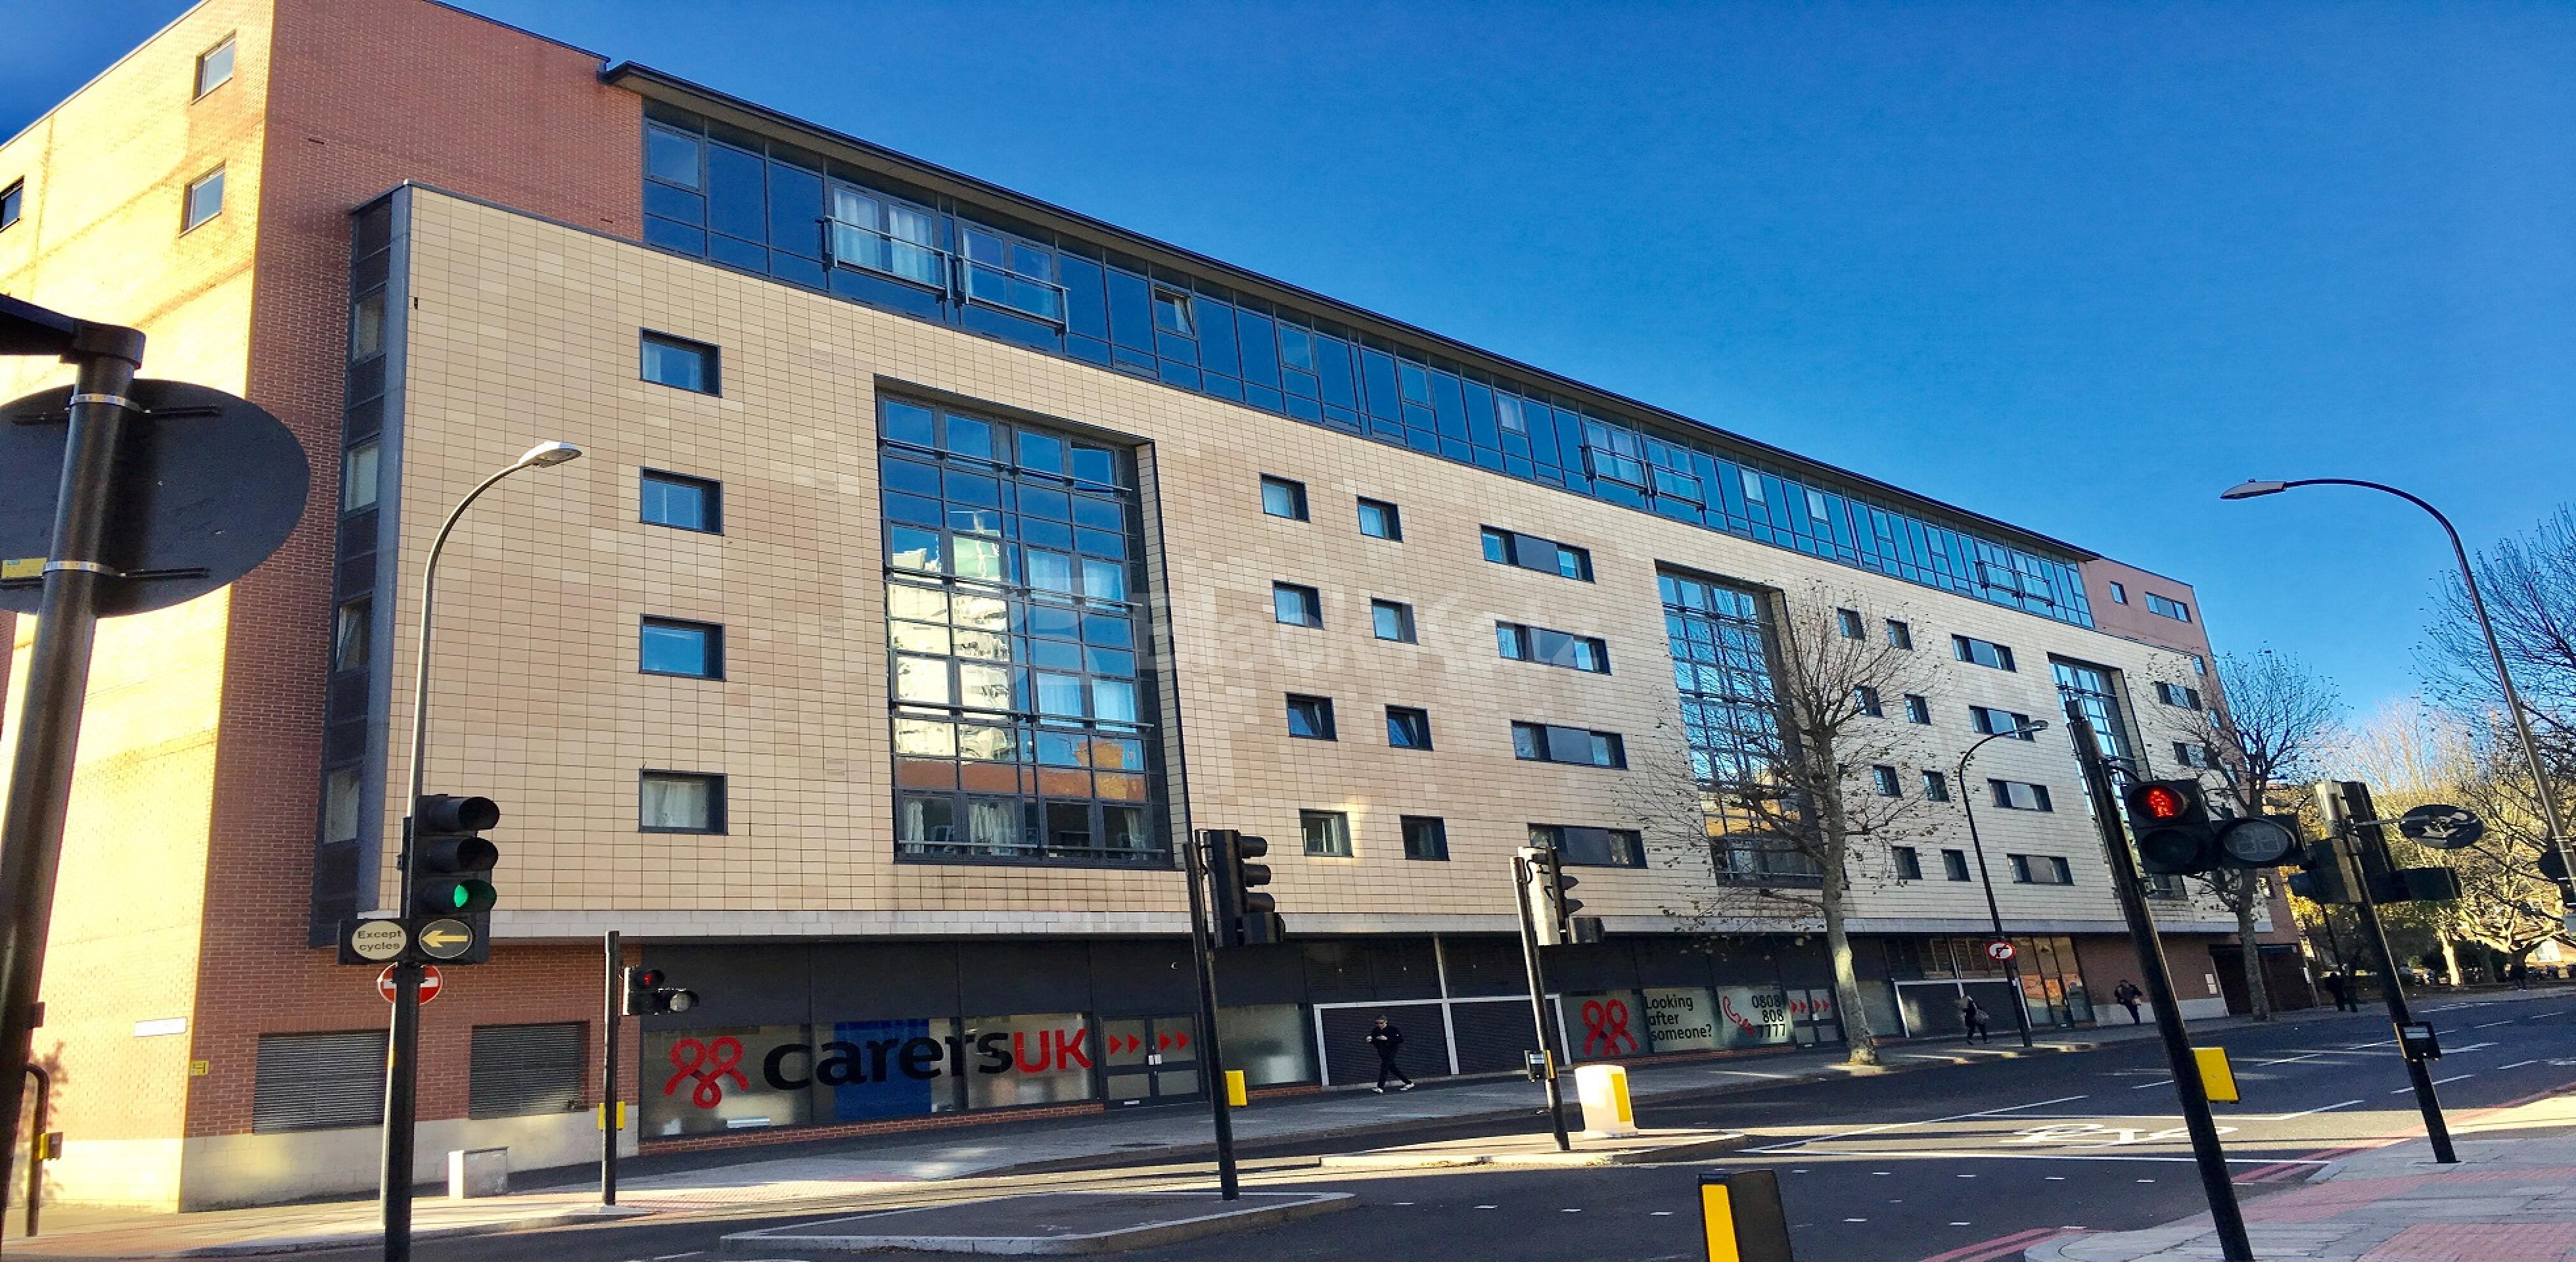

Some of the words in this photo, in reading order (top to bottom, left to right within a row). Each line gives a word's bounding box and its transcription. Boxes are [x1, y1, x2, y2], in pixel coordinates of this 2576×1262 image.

[357, 930, 401, 939] Except
[359, 942, 400, 952] cycles
[1644, 993, 1693, 1011] Looking
[1751, 994, 1780, 1008] 0808
[1649, 1010, 1678, 1025] after
[1762, 1009, 1783, 1023] 808
[1650, 1023, 1711, 1041] someone?
[1757, 1023, 1785, 1037] 7777
